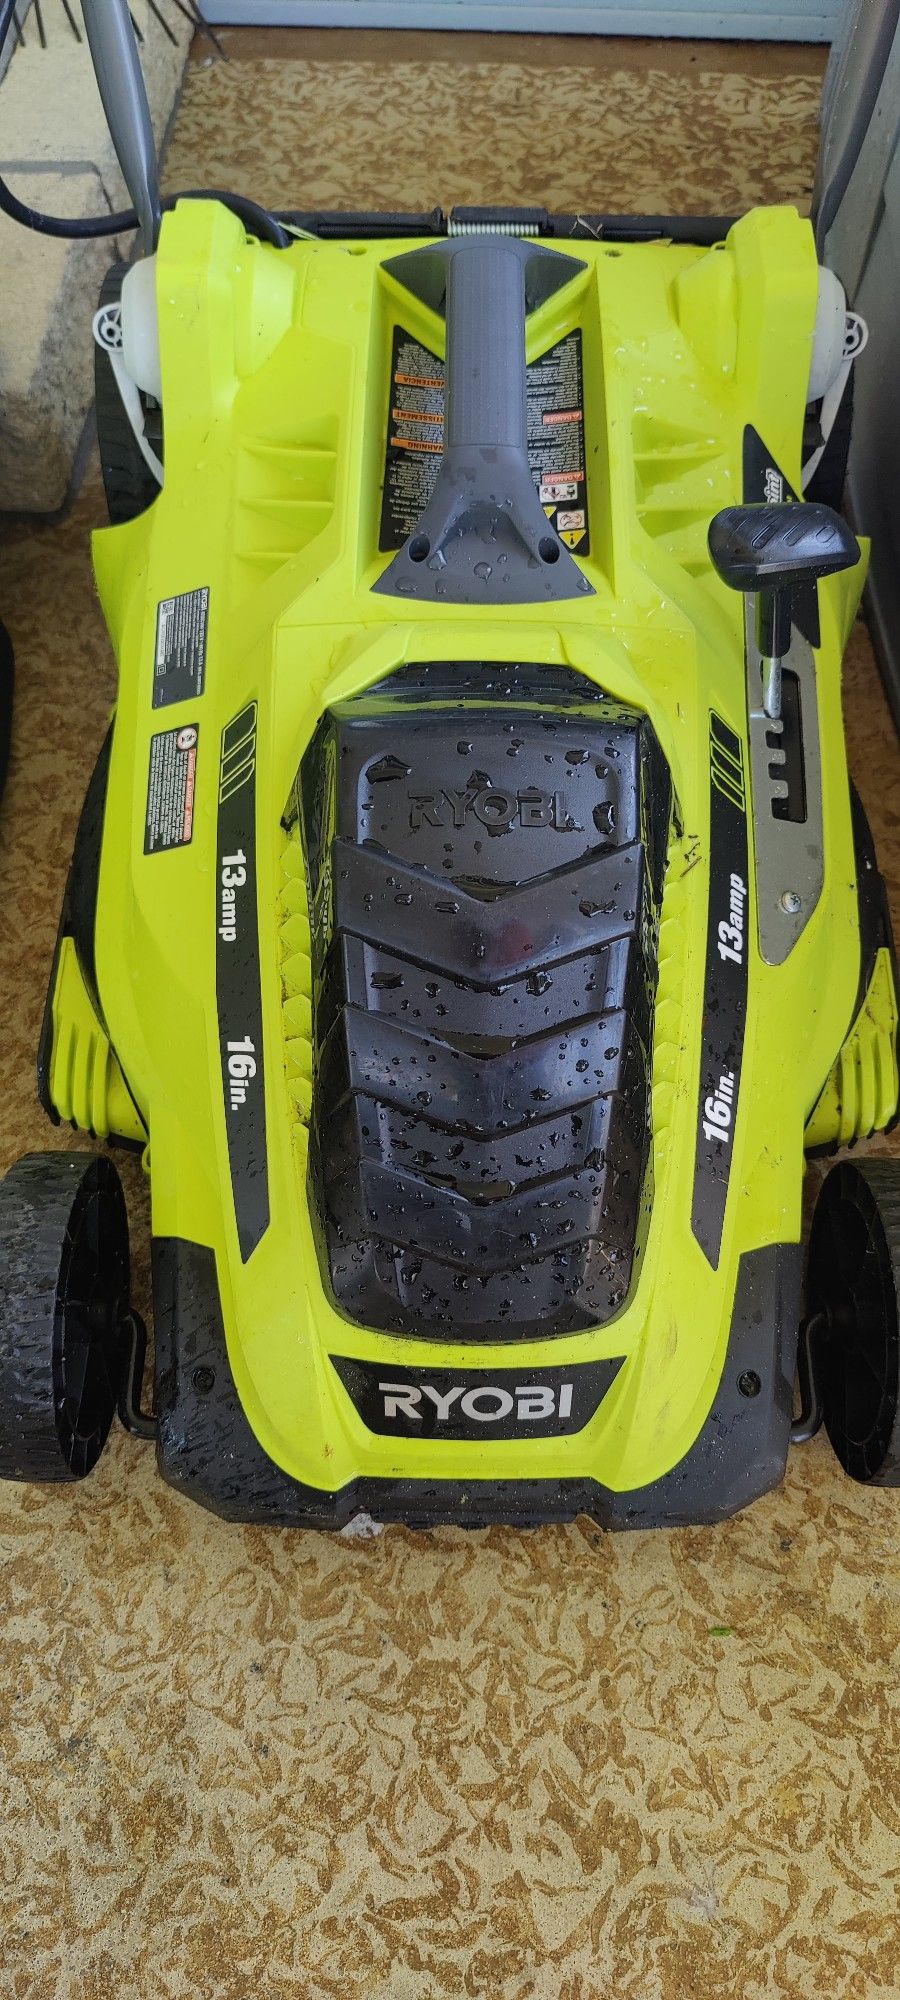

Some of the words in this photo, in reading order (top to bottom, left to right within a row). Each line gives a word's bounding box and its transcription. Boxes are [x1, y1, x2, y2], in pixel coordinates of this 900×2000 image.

[408, 787, 566, 827] RYOBI
[219, 849, 247, 942] 13amp
[717, 873, 747, 965] 13amp
[227, 1036, 257, 1110] 16in.
[702, 1072, 735, 1143] 16in.
[379, 1382, 573, 1421] RYOBI
